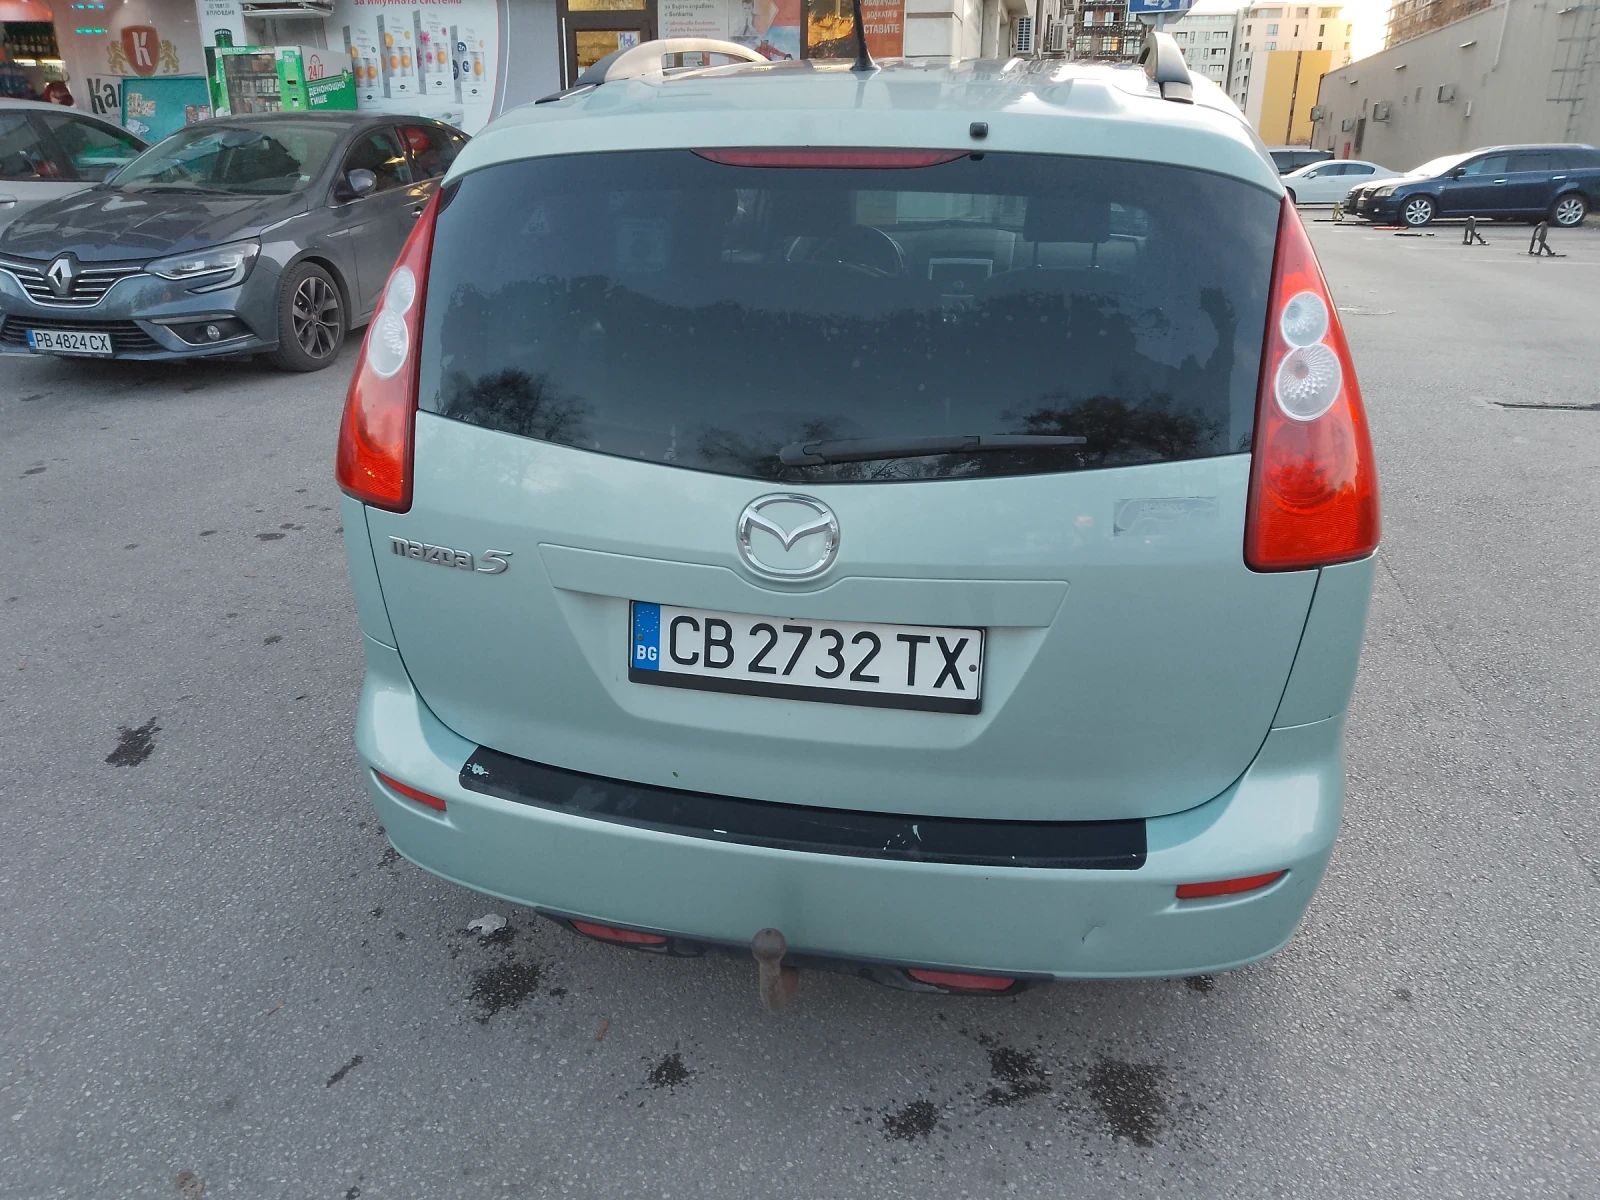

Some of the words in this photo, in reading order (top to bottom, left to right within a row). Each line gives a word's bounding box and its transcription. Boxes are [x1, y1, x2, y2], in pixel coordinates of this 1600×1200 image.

[864, 24, 900, 34] СТАВИТЕ
[308, 64, 324, 80] 24/7
[308, 81, 346, 97] ДЕНОНОЩНО
[310, 95, 328, 106] ГИШЕ
[55, 334, 87, 350] 4824
[477, 549, 513, 575] 5
[636, 645, 658, 661] BG
[669, 616, 735, 668] CB
[748, 623, 883, 684] 2732
[896, 633, 970, 690] TX
